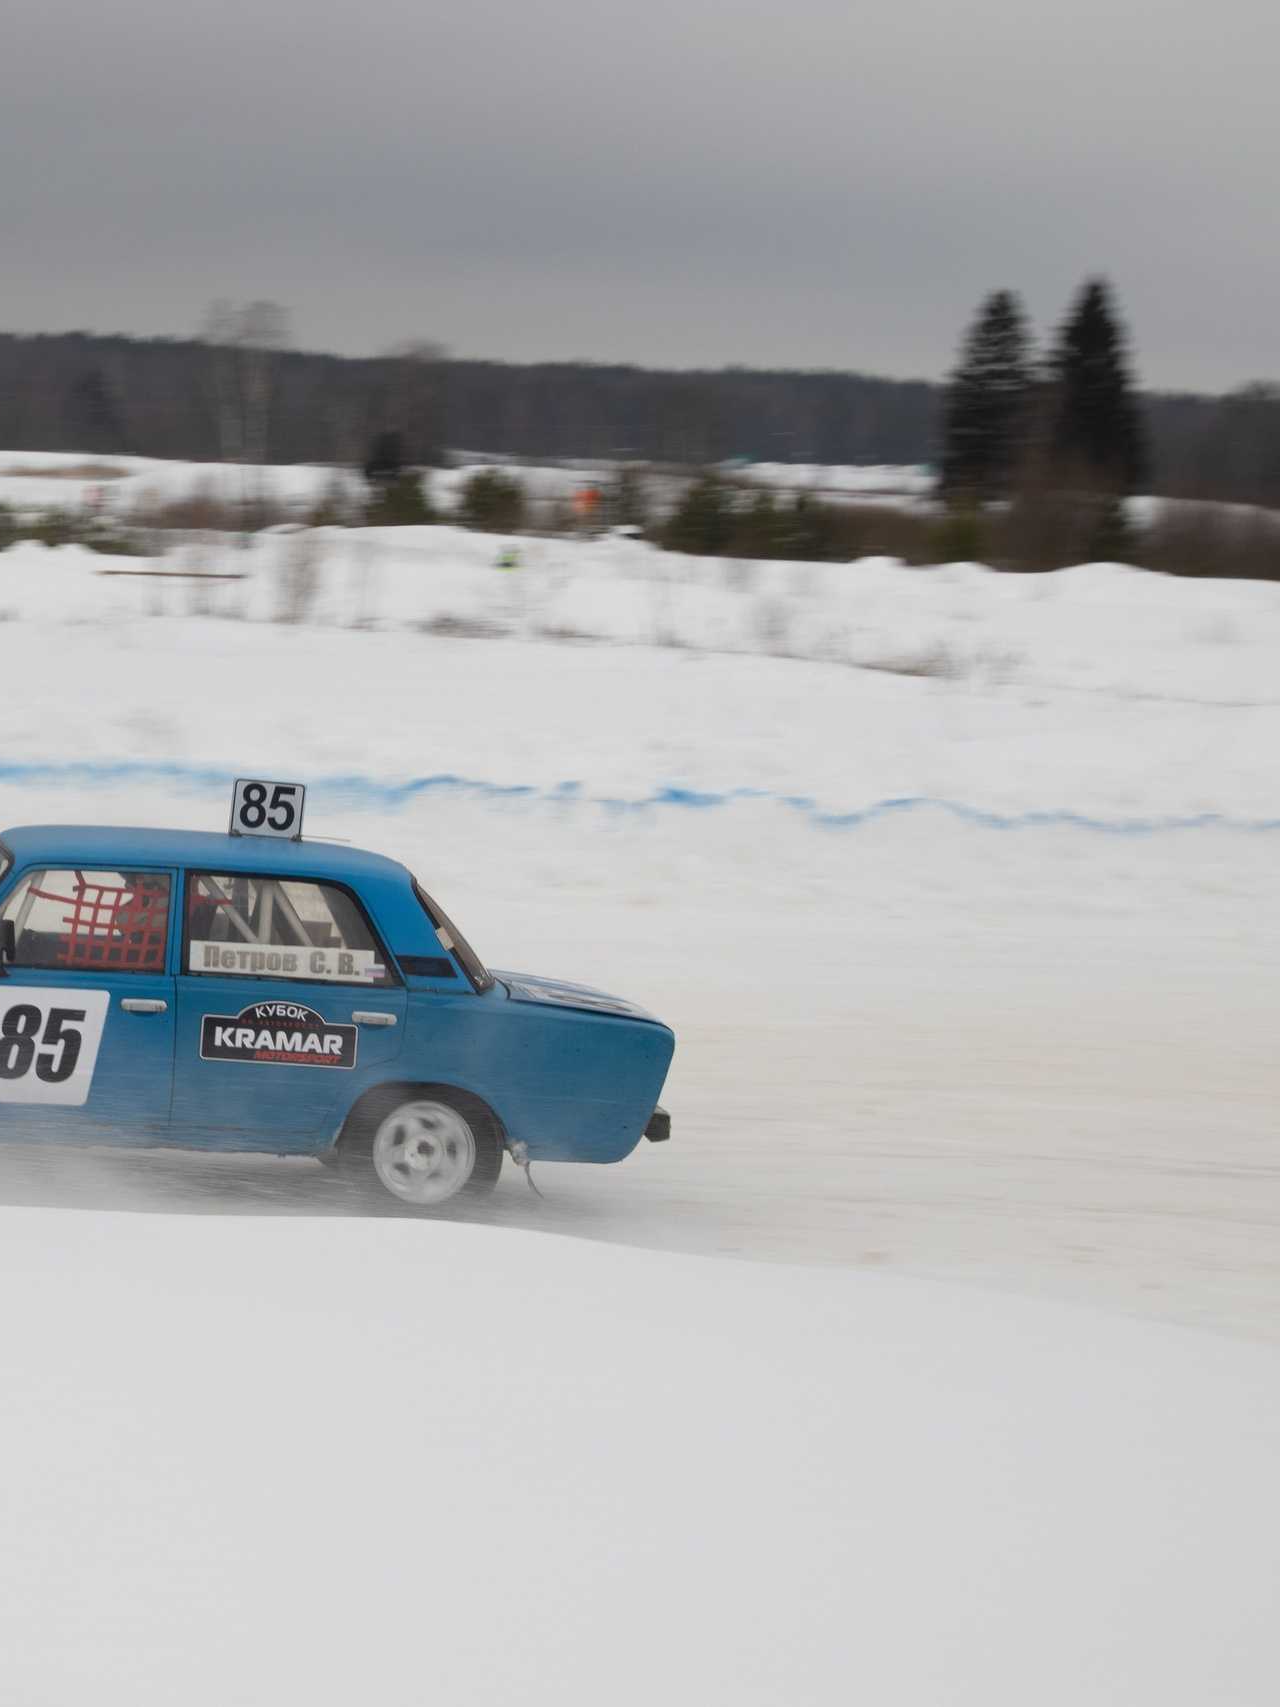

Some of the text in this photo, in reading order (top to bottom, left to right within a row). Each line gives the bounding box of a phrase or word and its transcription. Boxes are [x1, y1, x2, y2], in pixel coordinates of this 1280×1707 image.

[239, 783, 296, 831] 85
[203, 945, 360, 976] Петров С. В.
[255, 1004, 309, 1022] КУБОК
[214, 1026, 343, 1055] KRAMAR
[253, 1050, 342, 1065] MOTORSPORT
